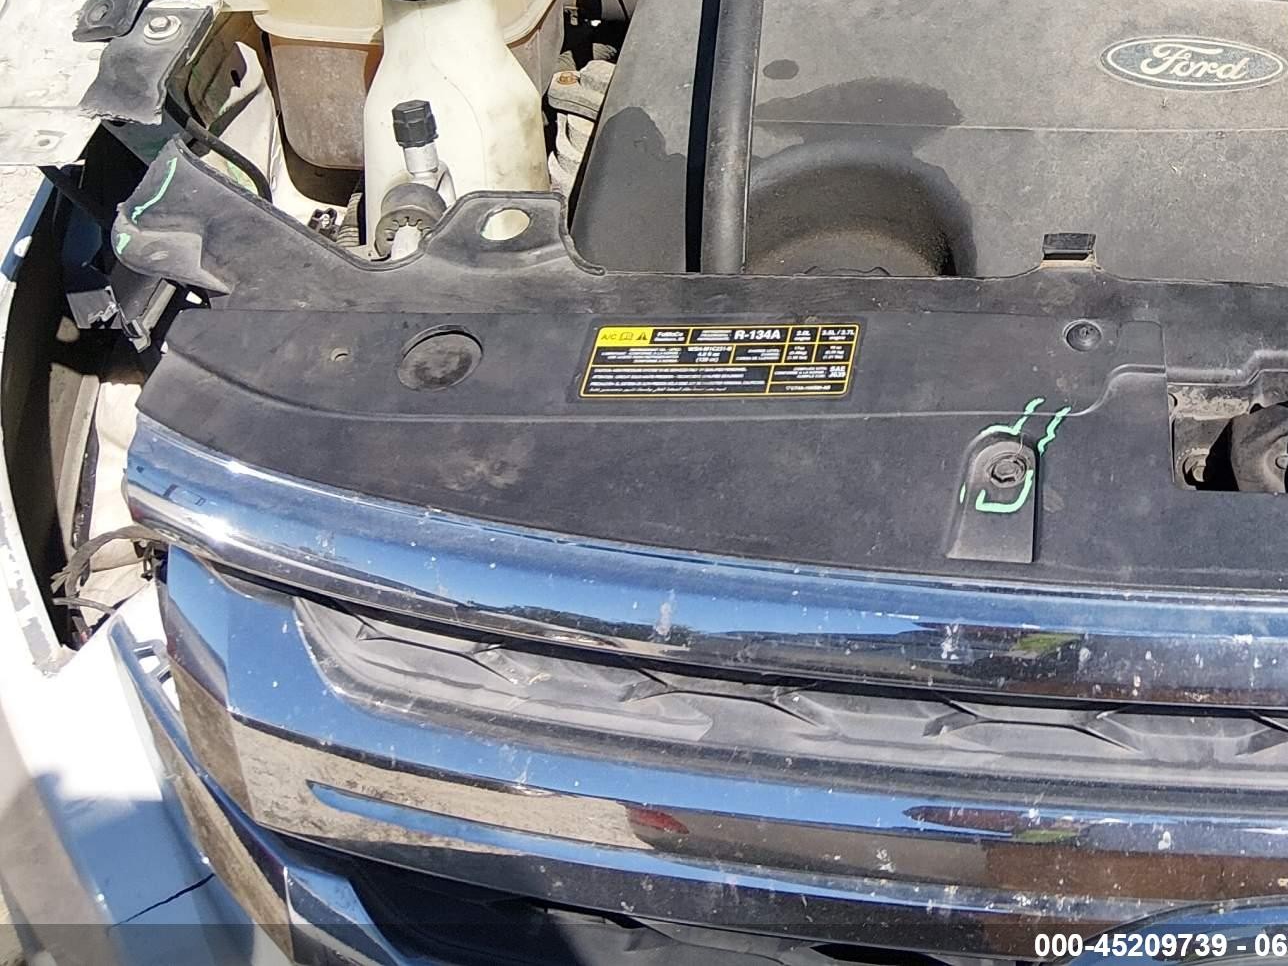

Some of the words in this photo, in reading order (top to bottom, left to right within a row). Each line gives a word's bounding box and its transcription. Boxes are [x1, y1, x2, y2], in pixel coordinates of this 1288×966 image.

[1140, 43, 1250, 80] Ford
[601, 333, 618, 341] A/C
[734, 329, 781, 340] R-134A
